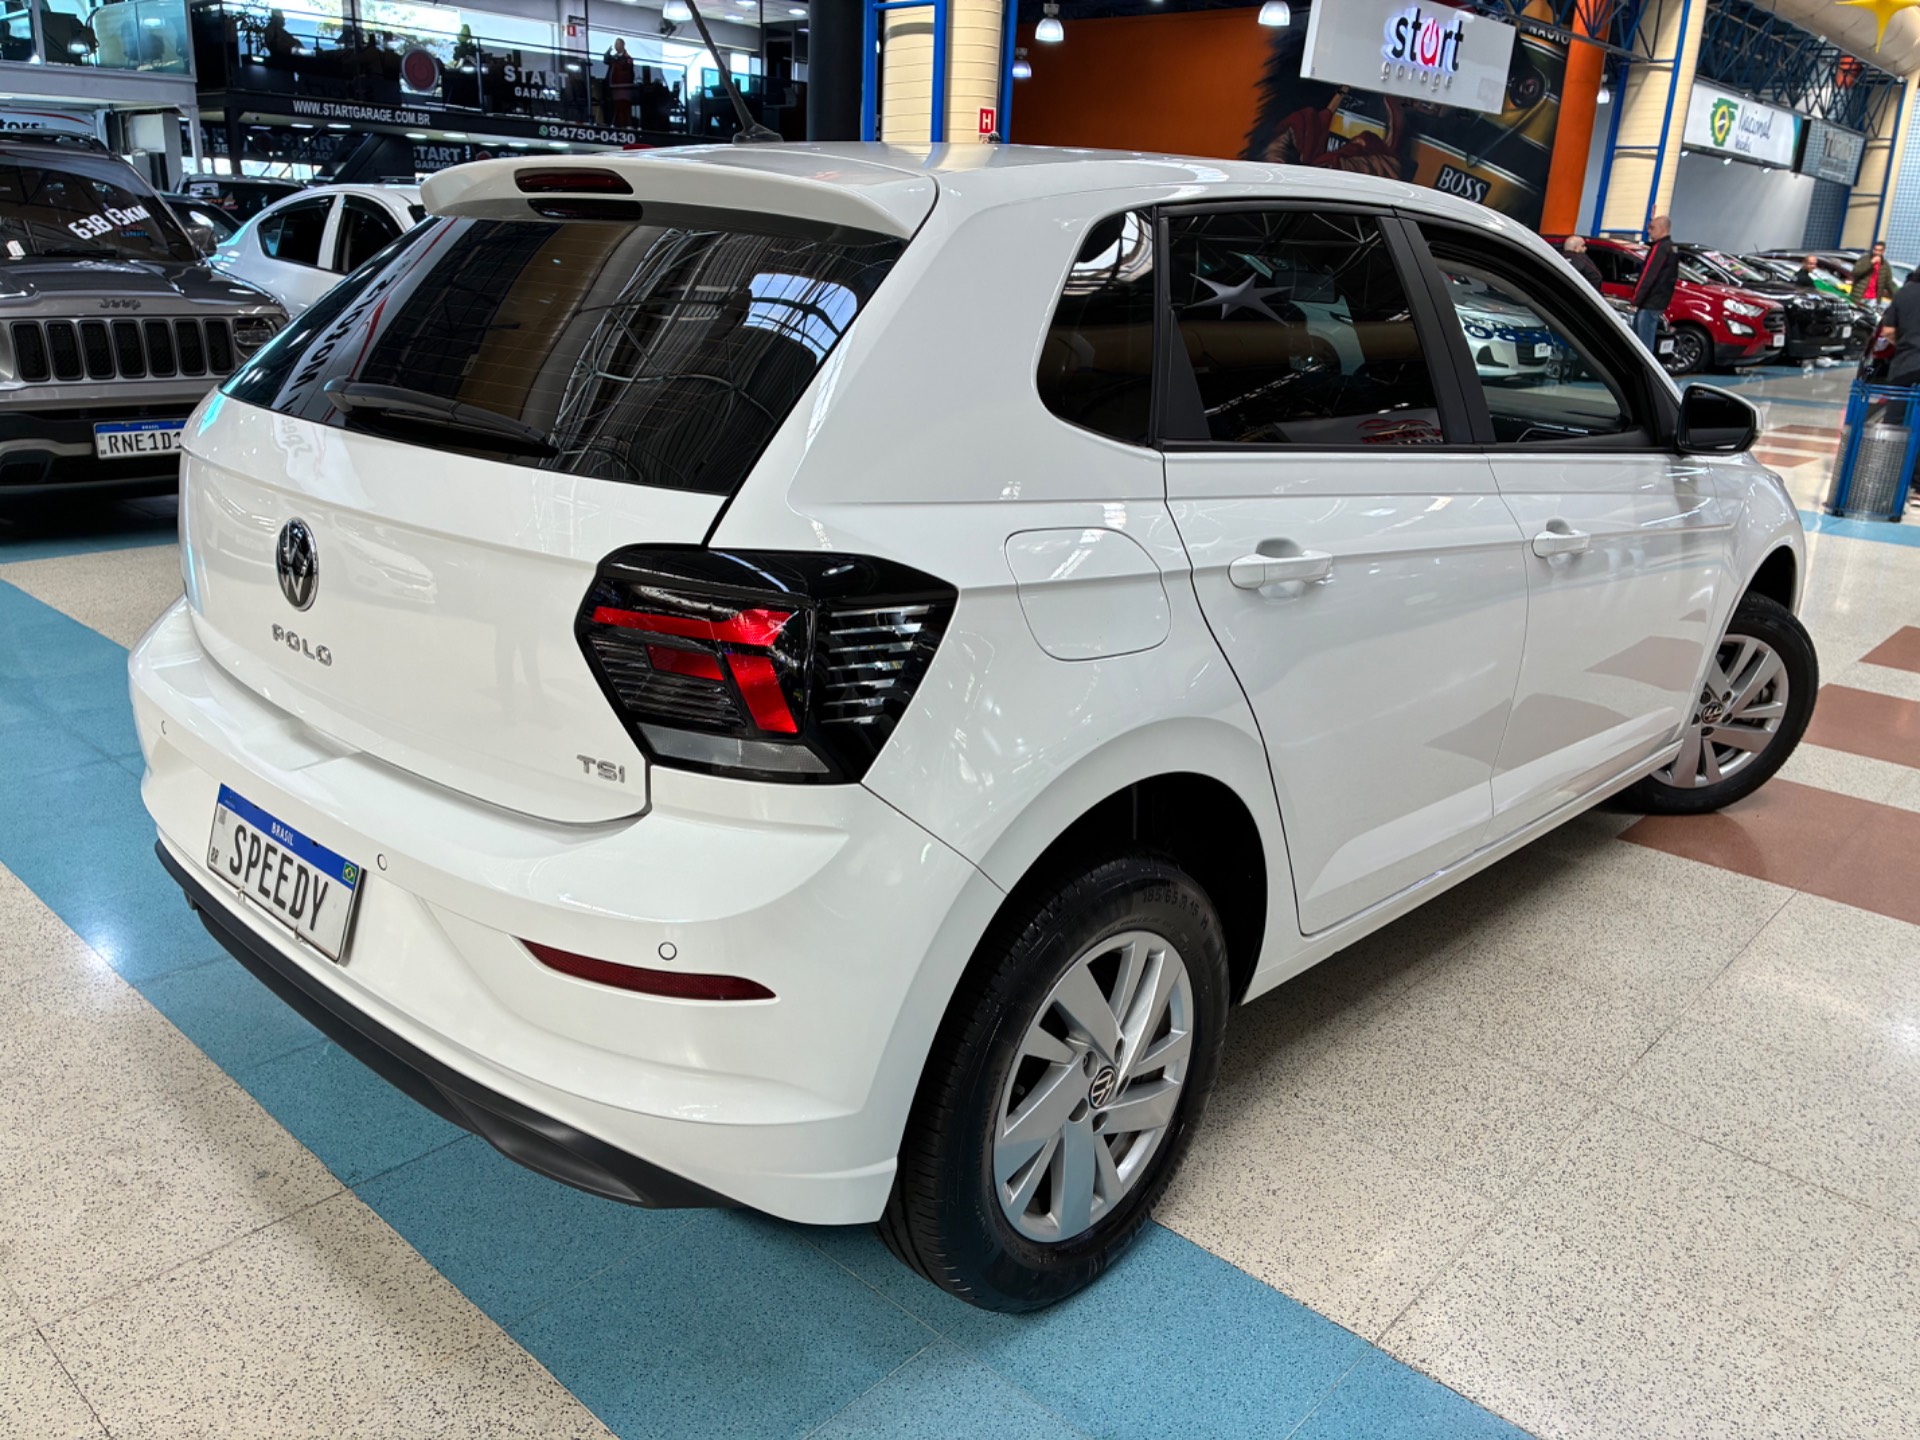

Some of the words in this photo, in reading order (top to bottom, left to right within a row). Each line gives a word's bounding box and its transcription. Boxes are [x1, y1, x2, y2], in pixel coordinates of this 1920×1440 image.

[1385, 7, 1464, 72] start
[504, 65, 569, 88] START
[1381, 61, 1453, 91] garage
[514, 86, 561, 101] GARAGE
[293, 100, 431, 126] WWW.STARTGARAGE.COM.BR
[982, 112, 992, 130] H
[549, 126, 636, 144] 94750-0430
[1437, 166, 1488, 203] BOSS
[100, 299, 141, 310] Jeep
[108, 430, 182, 455] RNE1D1
[272, 623, 332, 667] POLO
[576, 754, 625, 783] TSI
[271, 821, 294, 847] BRASIL
[229, 824, 329, 931] SPEEDY
